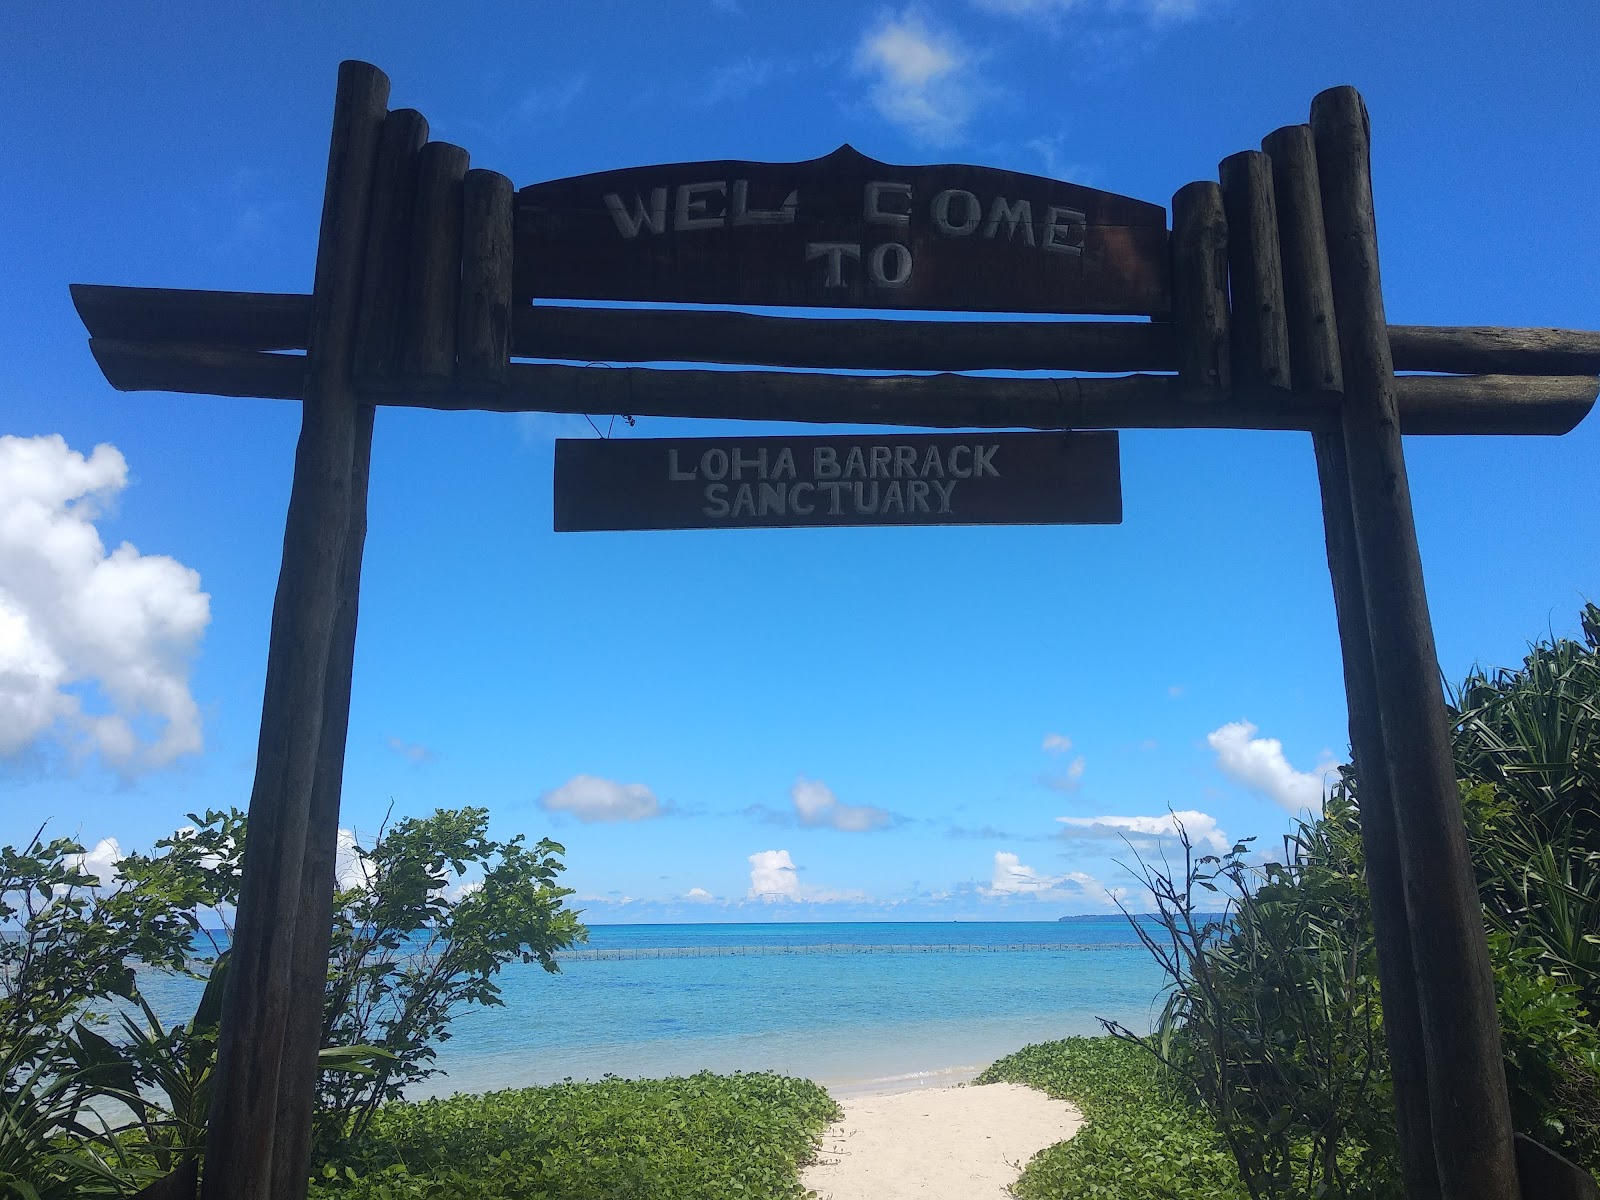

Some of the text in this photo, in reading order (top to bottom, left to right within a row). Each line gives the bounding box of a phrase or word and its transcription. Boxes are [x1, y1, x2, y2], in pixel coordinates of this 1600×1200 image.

[805, 242, 914, 288] TO
[668, 445, 1001, 481] LOHA BARRACK
[703, 480, 957, 519] SANCTUARY
